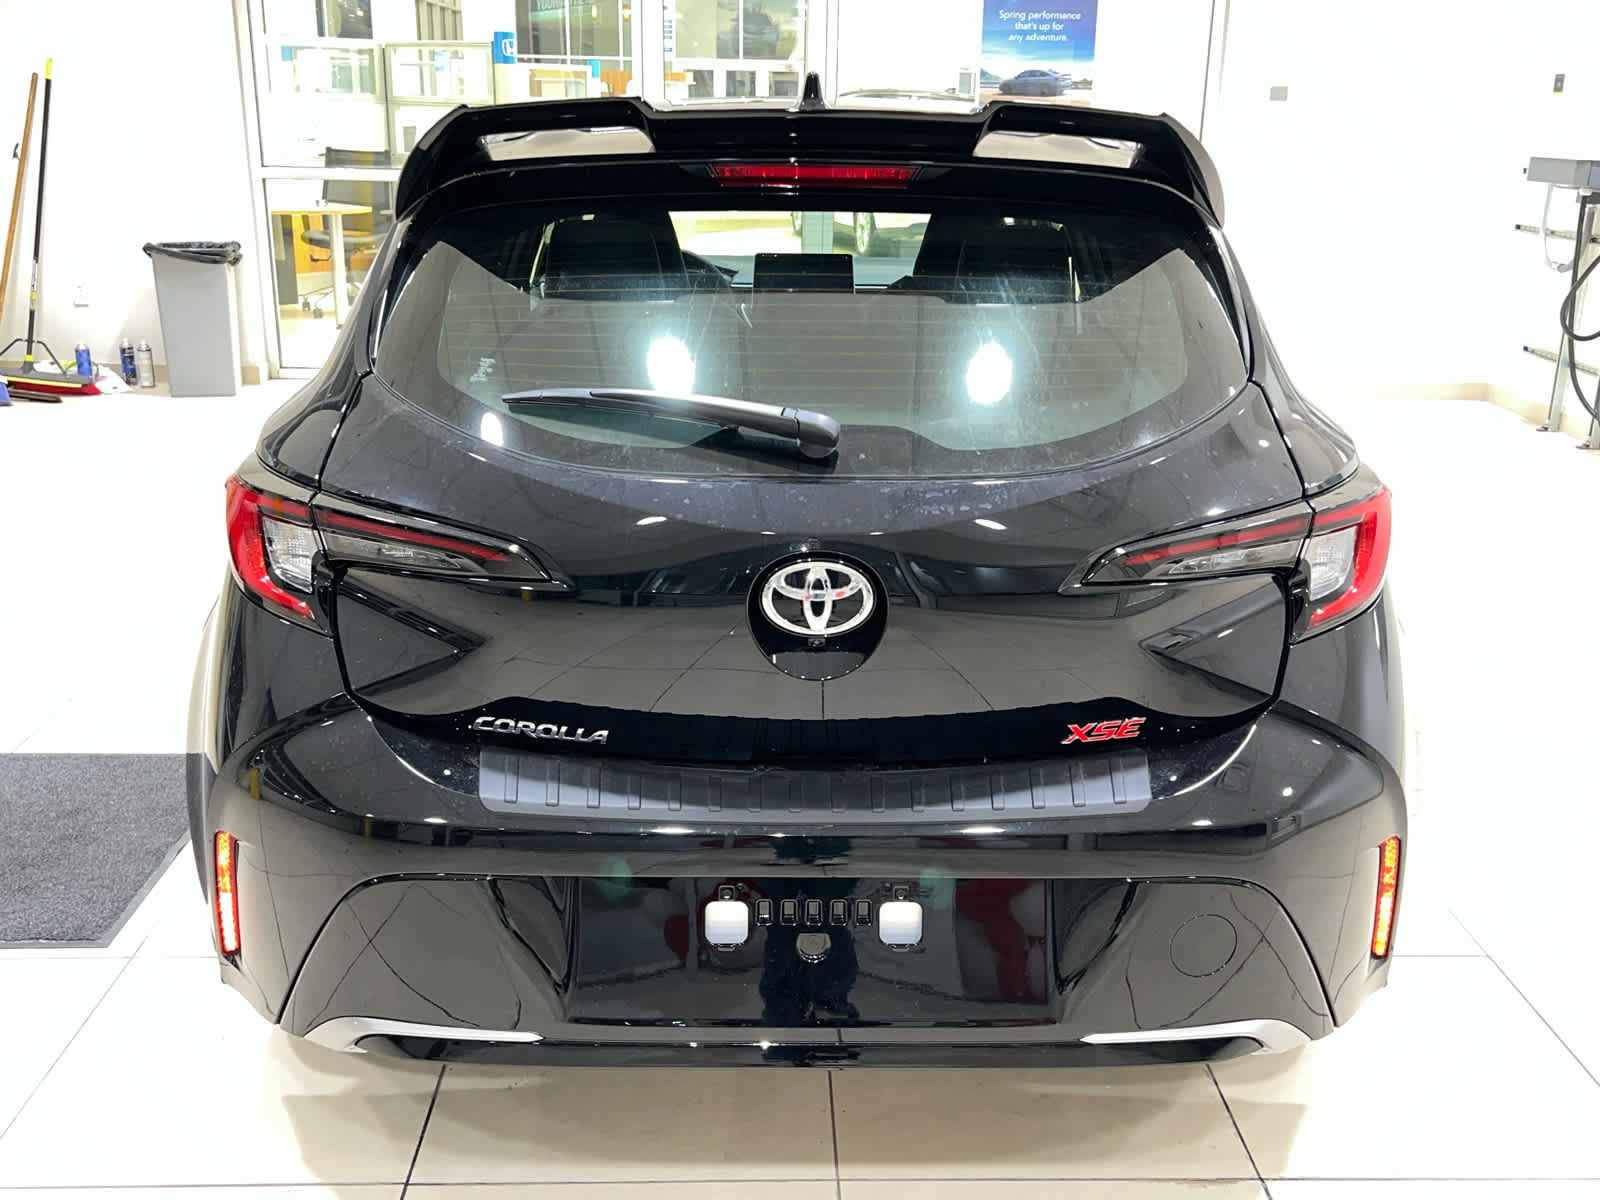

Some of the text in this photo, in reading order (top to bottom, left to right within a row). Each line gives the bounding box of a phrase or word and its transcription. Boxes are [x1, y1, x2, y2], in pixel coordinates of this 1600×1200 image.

[999, 10, 1081, 21] Spring performance
[1015, 21, 1064, 32] that's up for
[1008, 34, 1024, 43] any
[473, 716, 609, 744] COROLLA
[1060, 717, 1147, 744] XSE
